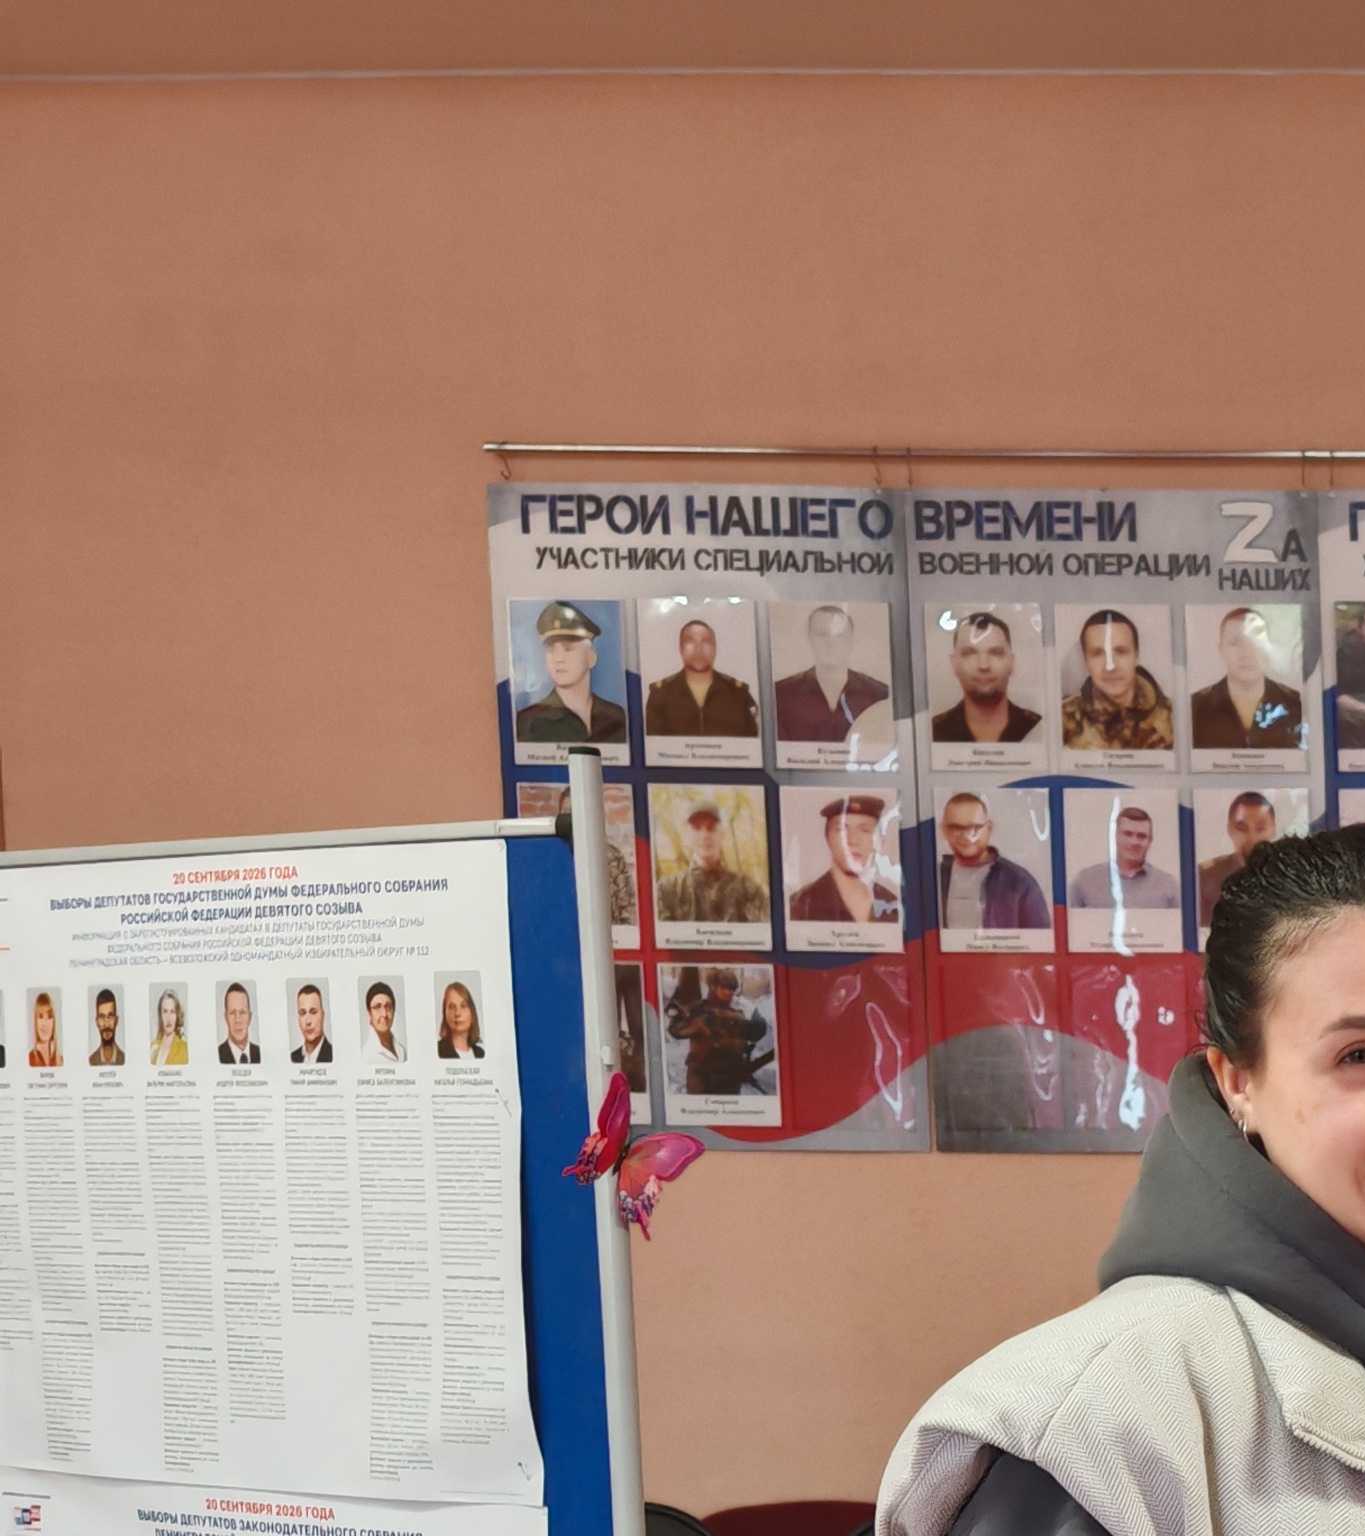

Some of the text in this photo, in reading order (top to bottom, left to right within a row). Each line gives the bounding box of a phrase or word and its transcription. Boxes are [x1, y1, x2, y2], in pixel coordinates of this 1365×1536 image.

[520, 494, 894, 540] ГЕРОИ НАШЕГО
[914, 501, 1137, 542] ВРЕМЕНИ
[535, 546, 894, 577] УЧАСТНИКИ СПЕЦИАЛЬНОЙ
[919, 550, 1211, 581] ВОЕННОЙ ОПЕРАЦИИ
[1219, 568, 1311, 591] НАШИХ
[173, 865, 299, 885] 20 СЕНТЯБРЯ 2026 ГОДА
[50, 878, 449, 911] ВЫБОРЫ ДЕПУТАТОВ ГОСУДАРСТВЕННОЙ ДУМЫ ФЕДЕРАЛЬНОГО СОБРАНИЯ
[121, 901, 363, 925] РОССИЙСКОЙ ФЕДЕРАЦИИ ДЕВЯТОГО СОЗЫВА
[137, 1508, 179, 1524] ВЫБОРЫ
[181, 1512, 237, 1531] ДЕПУТАТОВ
[205, 1498, 336, 1520] 20 СЕНТЯБРЯ 2026 ГОДА
